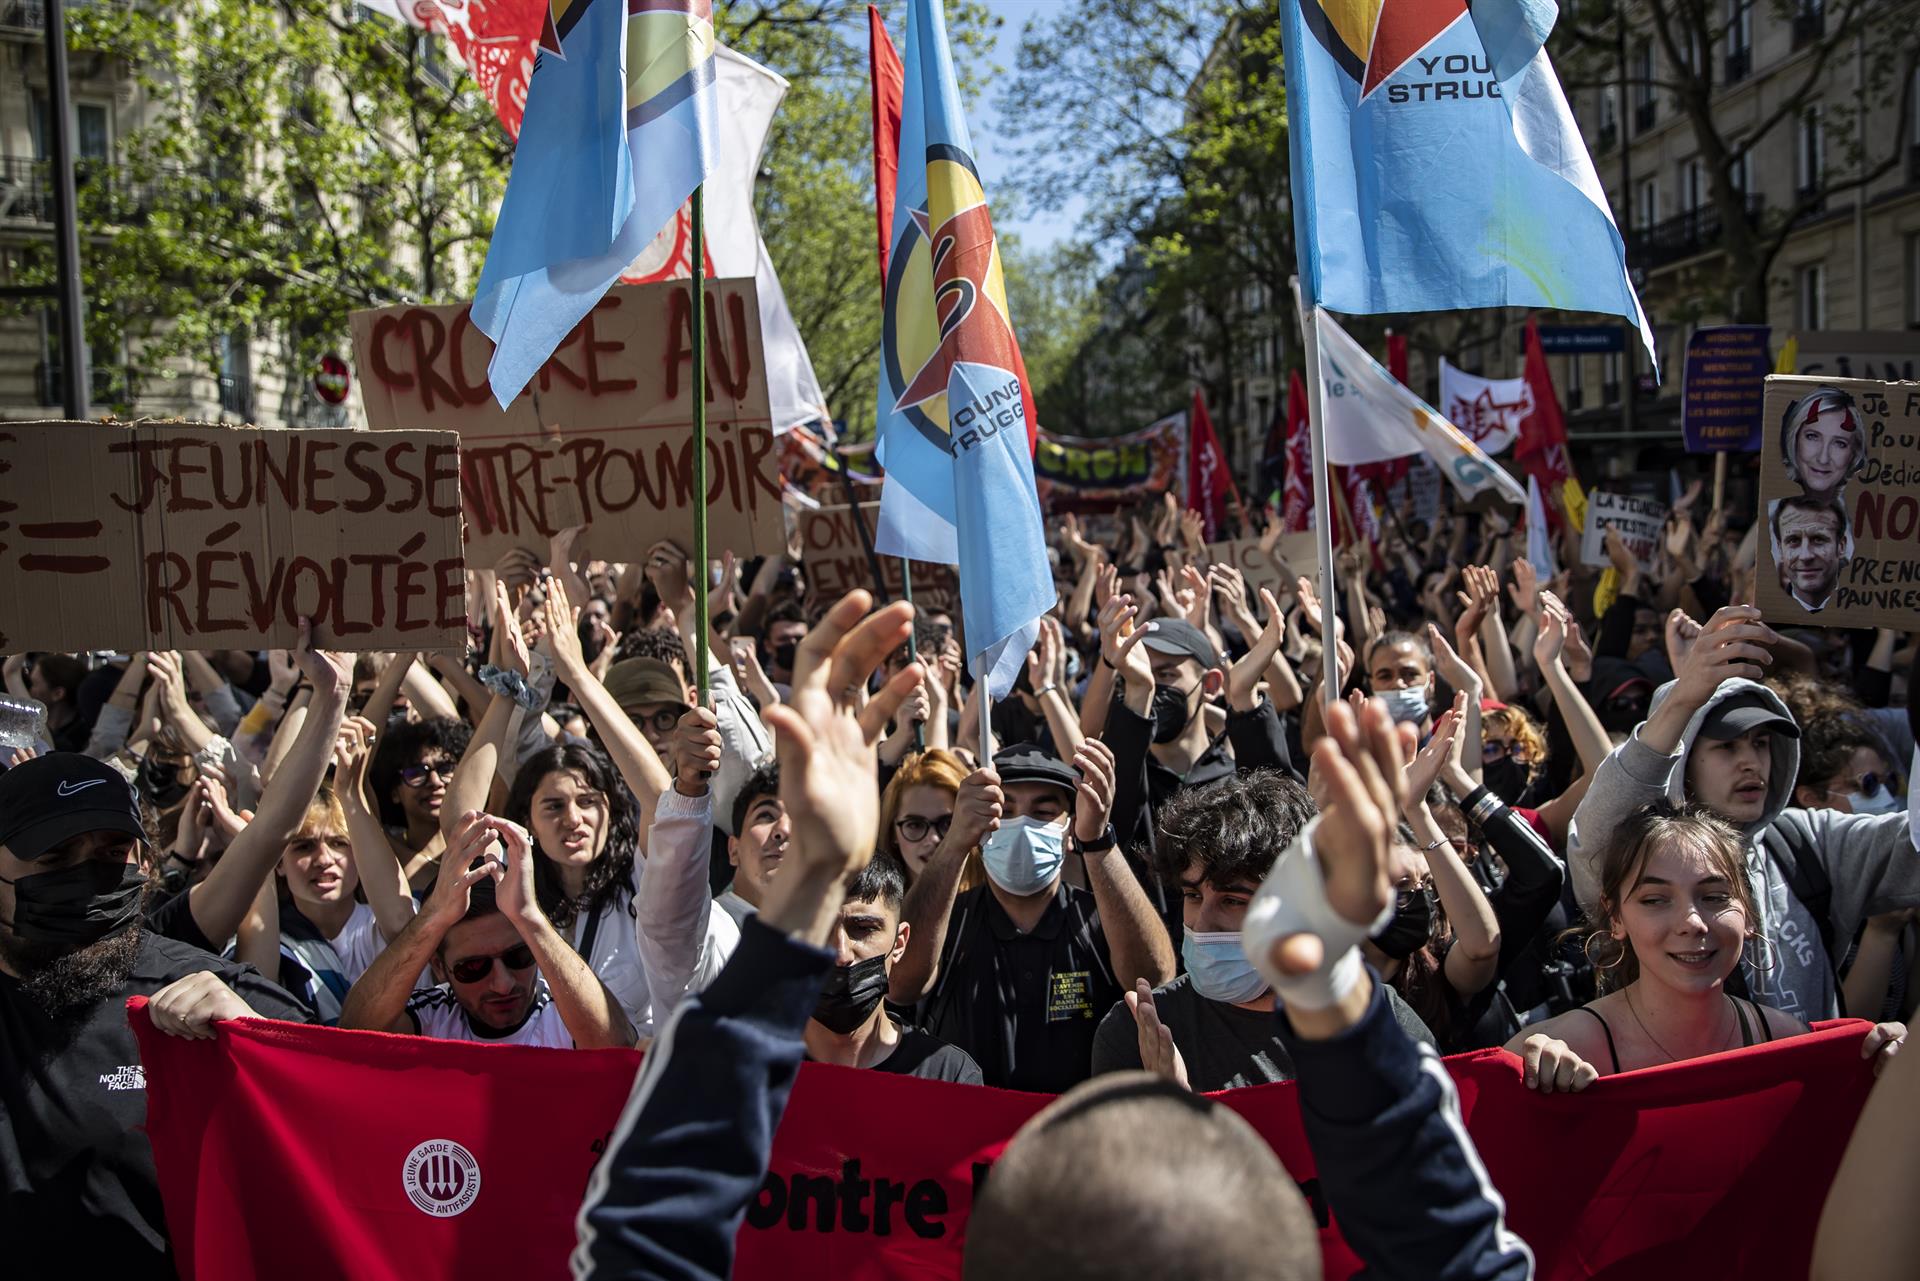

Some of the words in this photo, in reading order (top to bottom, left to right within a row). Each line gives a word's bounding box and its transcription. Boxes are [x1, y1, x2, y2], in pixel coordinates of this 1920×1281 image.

[371, 295, 638, 413] CRORE
[665, 286, 752, 403] AU
[1862, 392, 1891, 417] Je
[109, 438, 462, 517] JEUNESSE
[1854, 490, 1920, 546] NO
[145, 521, 466, 635] RÉVOLTÉE
[99, 1074, 134, 1084] NORTH
[108, 1082, 133, 1090] FACE
[116, 1065, 135, 1075] THE
[407, 1156, 420, 1187] JEUNE
[417, 1143, 449, 1159] GARDE
[436, 1170, 477, 1214] ANTIFASCISTE
